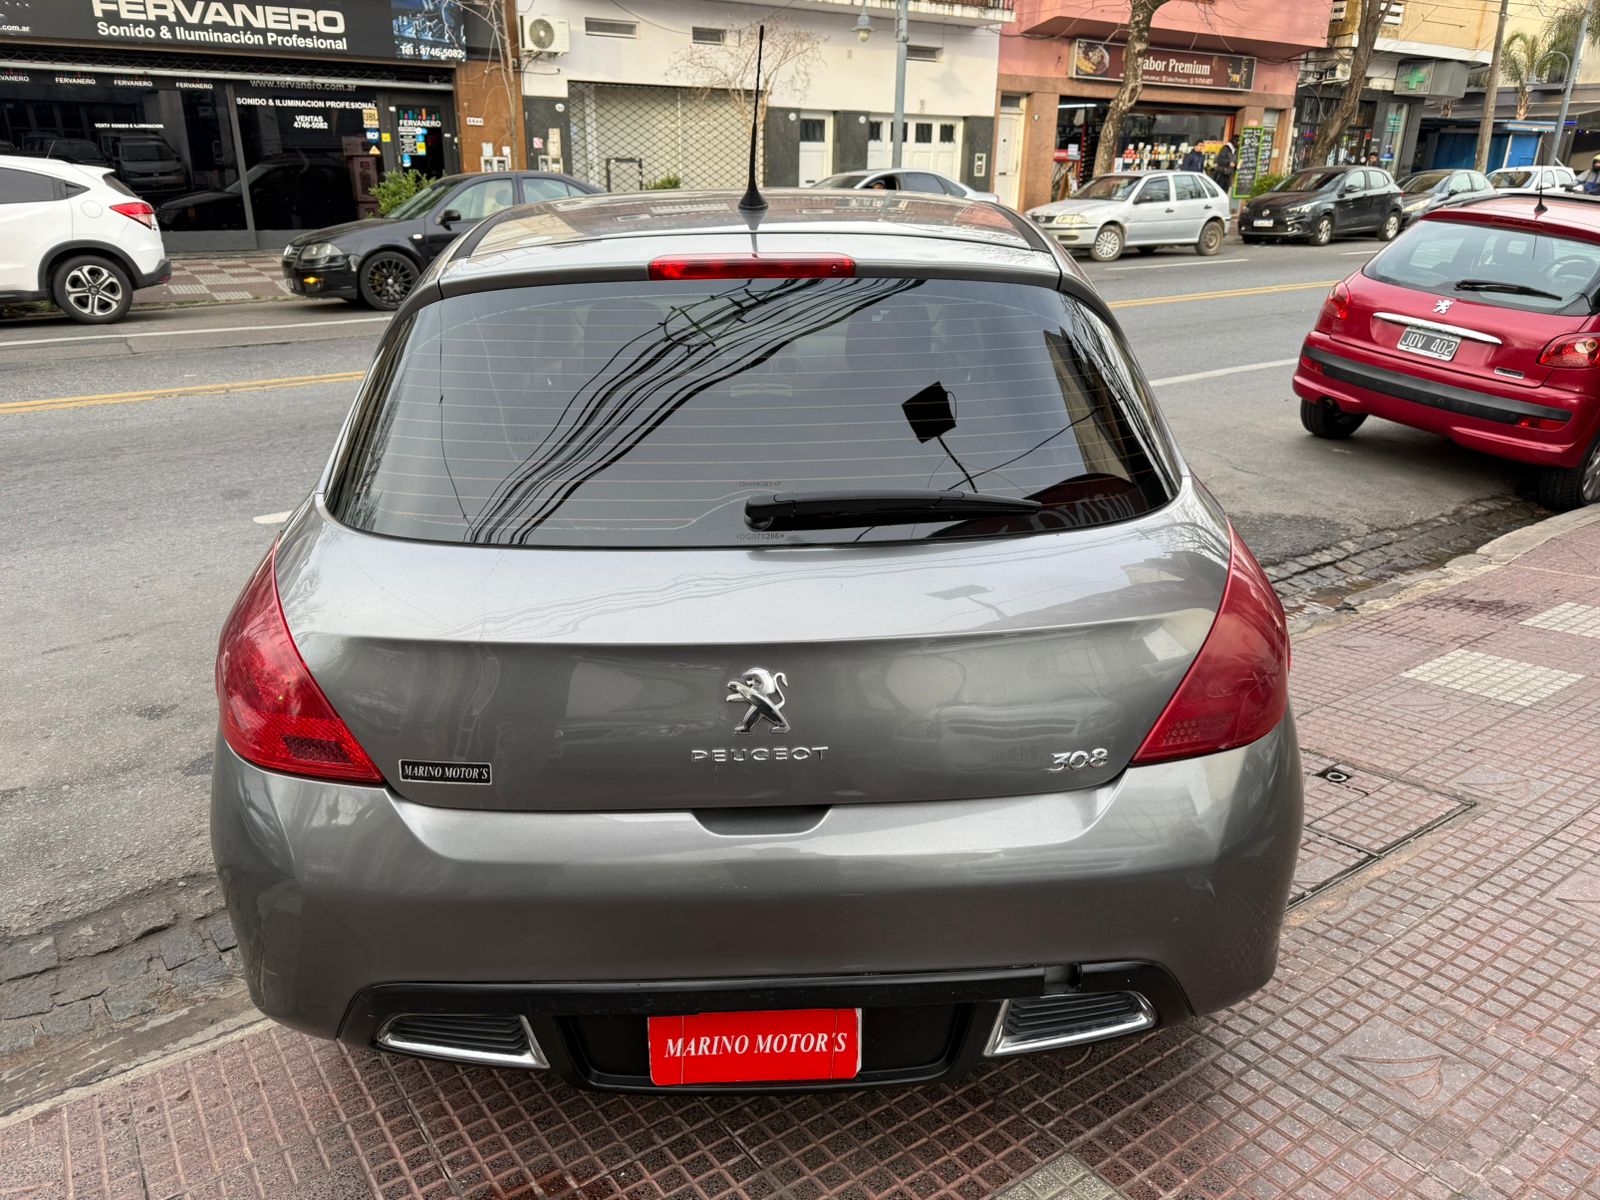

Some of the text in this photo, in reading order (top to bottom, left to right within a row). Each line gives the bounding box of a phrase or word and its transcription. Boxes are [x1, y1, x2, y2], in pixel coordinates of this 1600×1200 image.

[92, 0, 345, 34] FERVANERO
[97, 22, 348, 50] Sonido & Iluminación Profesional
[1168, 58, 1211, 75] Premium
[55, 77, 96, 85] FERVANERO
[114, 79, 153, 87] FERVANERO
[176, 82, 213, 90] FERVANERO
[236, 97, 376, 109] SONIDO & ILUMINACION PROFESIONAL
[399, 119, 441, 127] FERVANERO
[1402, 333, 1456, 356] JOV 402
[691, 746, 829, 762] PEUGEOT
[1046, 747, 1108, 772] 308
[404, 764, 442, 777] MARINO
[664, 1034, 749, 1058] MARINO
